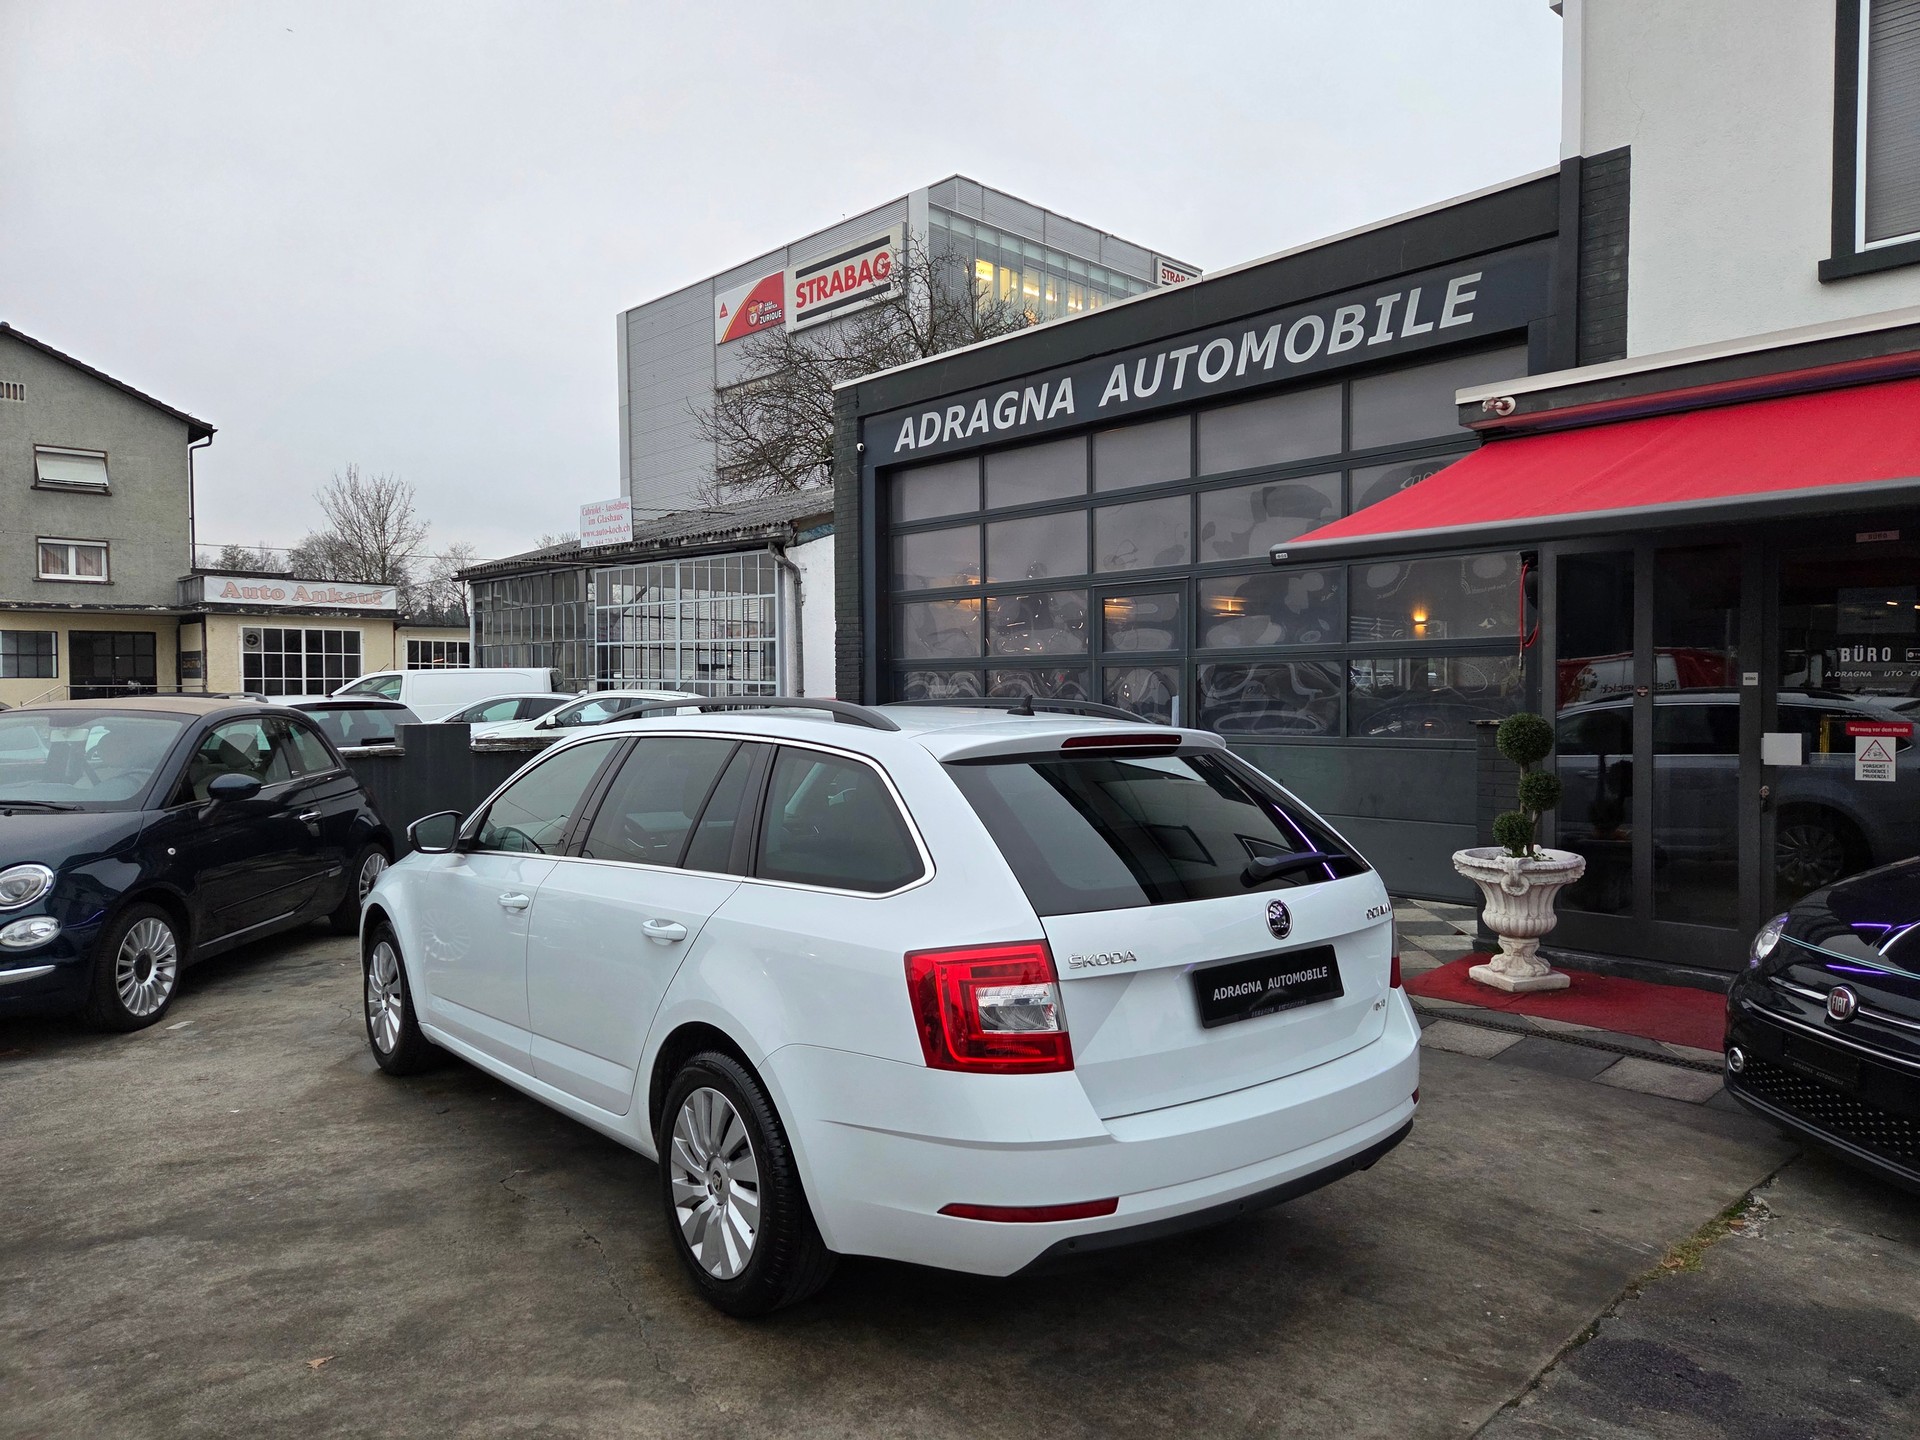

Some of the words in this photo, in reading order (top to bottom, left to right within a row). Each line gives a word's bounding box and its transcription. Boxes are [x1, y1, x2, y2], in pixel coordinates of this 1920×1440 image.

[796, 251, 892, 309] STRABAG
[1162, 268, 1190, 283] STRAB
[759, 309, 782, 325] ZURIQUE
[894, 376, 1076, 453] ADRAGNA
[1098, 271, 1483, 407] AUTOMOBILE
[582, 505, 601, 516] Cabriolet
[606, 501, 629, 512] Ausstellung
[588, 516, 596, 525] im
[597, 513, 623, 524] Glashaus
[582, 523, 630, 538] www.auto-koch.ch
[220, 581, 286, 601] Auto
[291, 585, 384, 605] Ankauf
[1840, 645, 1891, 662] BÜRO
[1067, 950, 1137, 970] ŠKODA
[1213, 979, 1263, 1001] ADRAGNA
[1267, 966, 1328, 990] AUTOMOBILE
[1831, 996, 1848, 1013] FIAT
